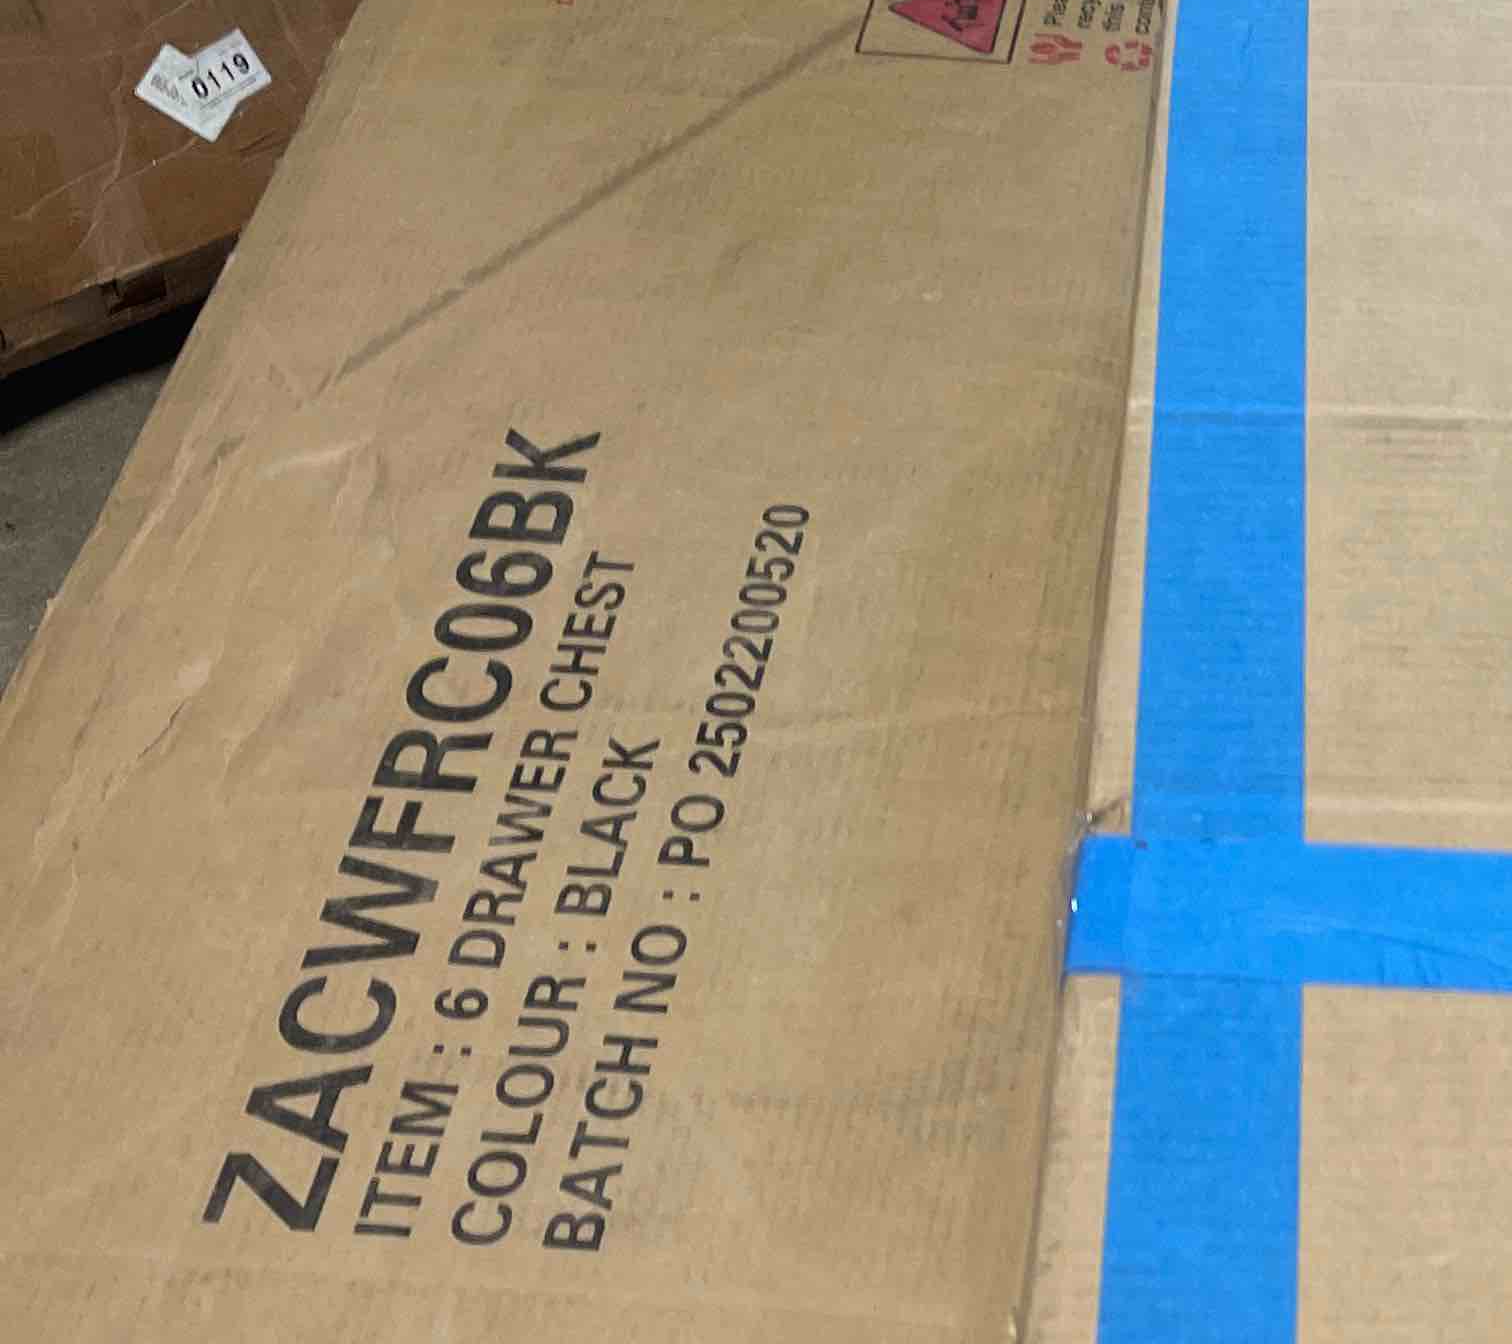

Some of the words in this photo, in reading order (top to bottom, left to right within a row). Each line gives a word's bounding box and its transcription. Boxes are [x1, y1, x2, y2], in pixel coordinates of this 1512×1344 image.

[190, 52, 250, 99] 0119
[540, 550, 636, 713] CHEST
[688, 503, 811, 778] 2502200520
[201, 428, 602, 1236] ZACWFRC06BK
[448, 726, 580, 970] DRAWER
[659, 795, 727, 869] PO
[434, 988, 489, 1021] 6
[451, 974, 585, 1248] COLOUR
[558, 735, 663, 916] BLACK
[614, 924, 690, 1013] NO
[354, 1078, 460, 1239] ITEM
[542, 1036, 659, 1252] BATCH
